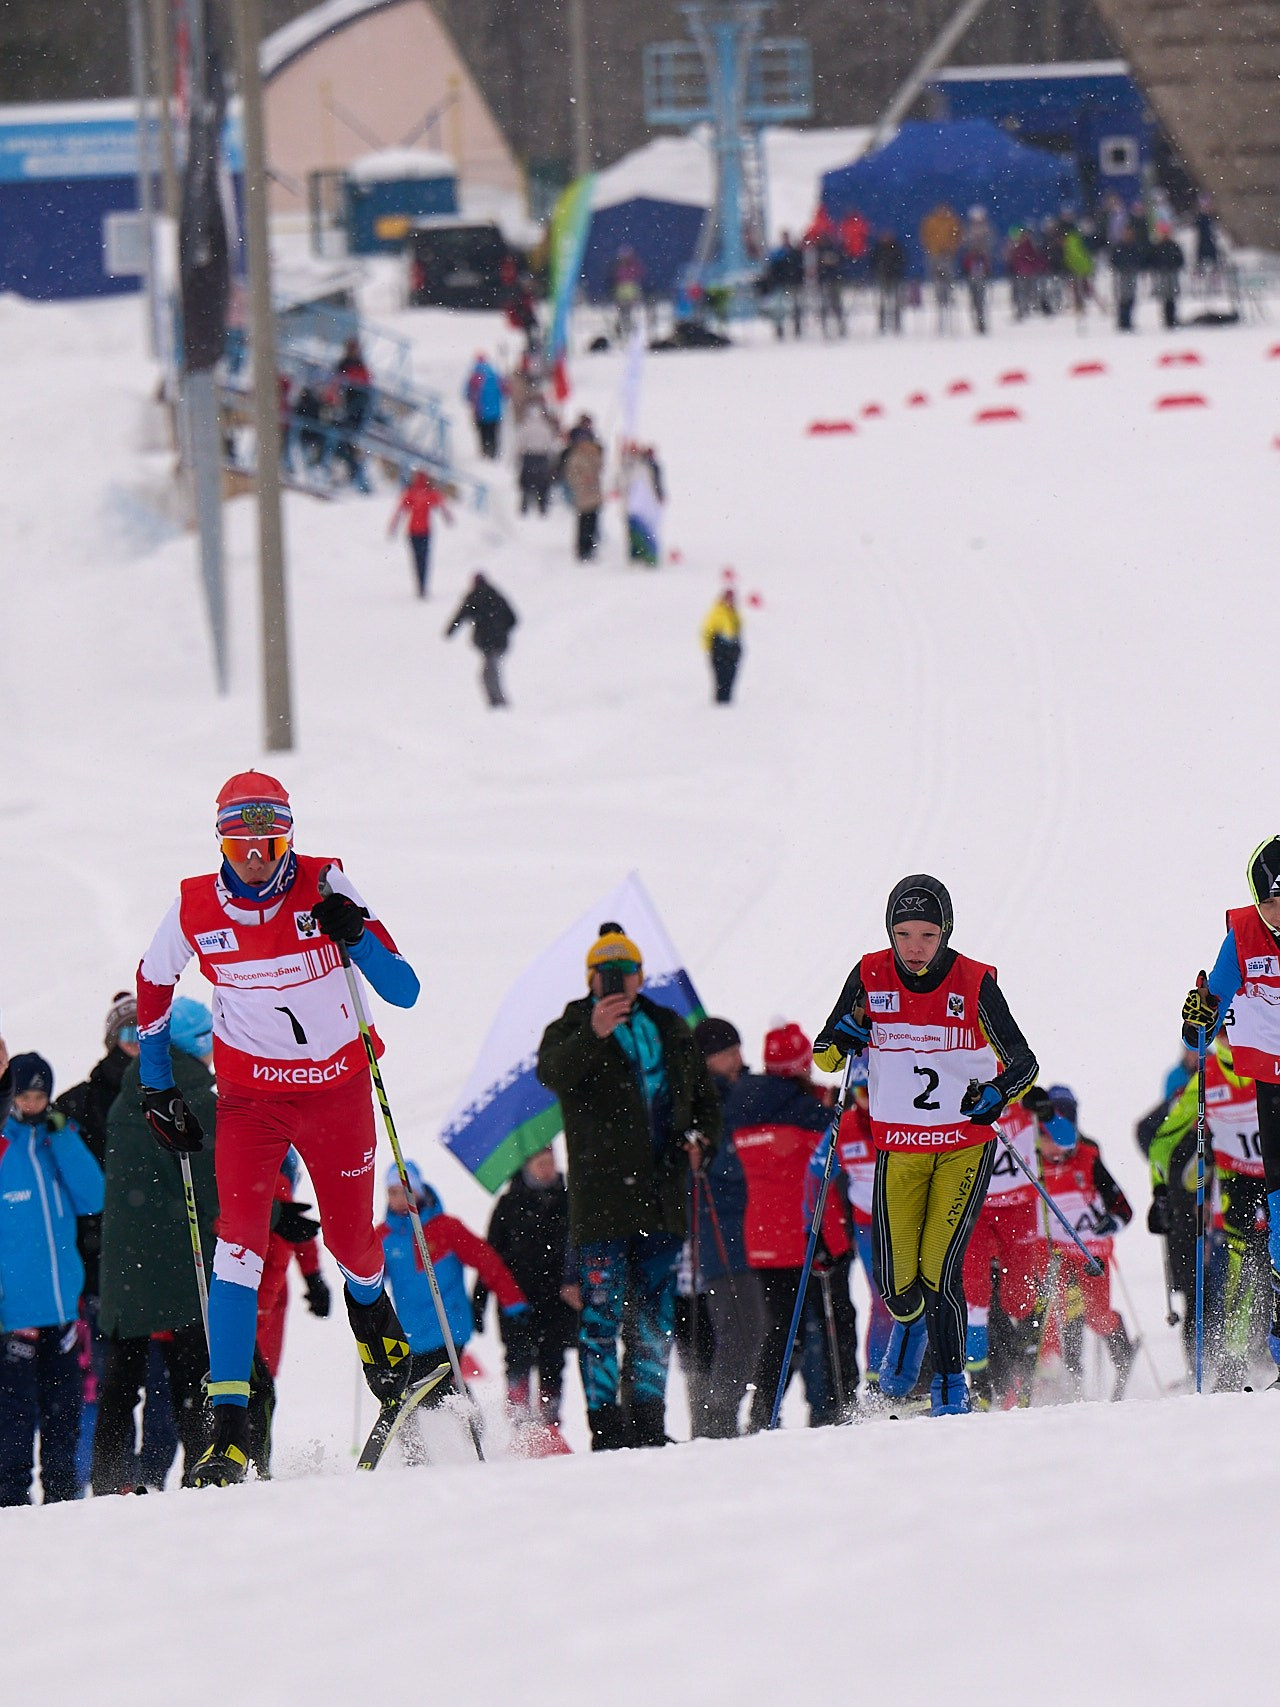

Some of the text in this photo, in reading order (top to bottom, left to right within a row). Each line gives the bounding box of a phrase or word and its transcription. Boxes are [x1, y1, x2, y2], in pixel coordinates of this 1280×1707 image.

[274, 1006, 308, 1045] 1
[340, 1003, 349, 1019] 1
[913, 1066, 940, 1111] 2
[1197, 1102, 1205, 1154] SPINE
